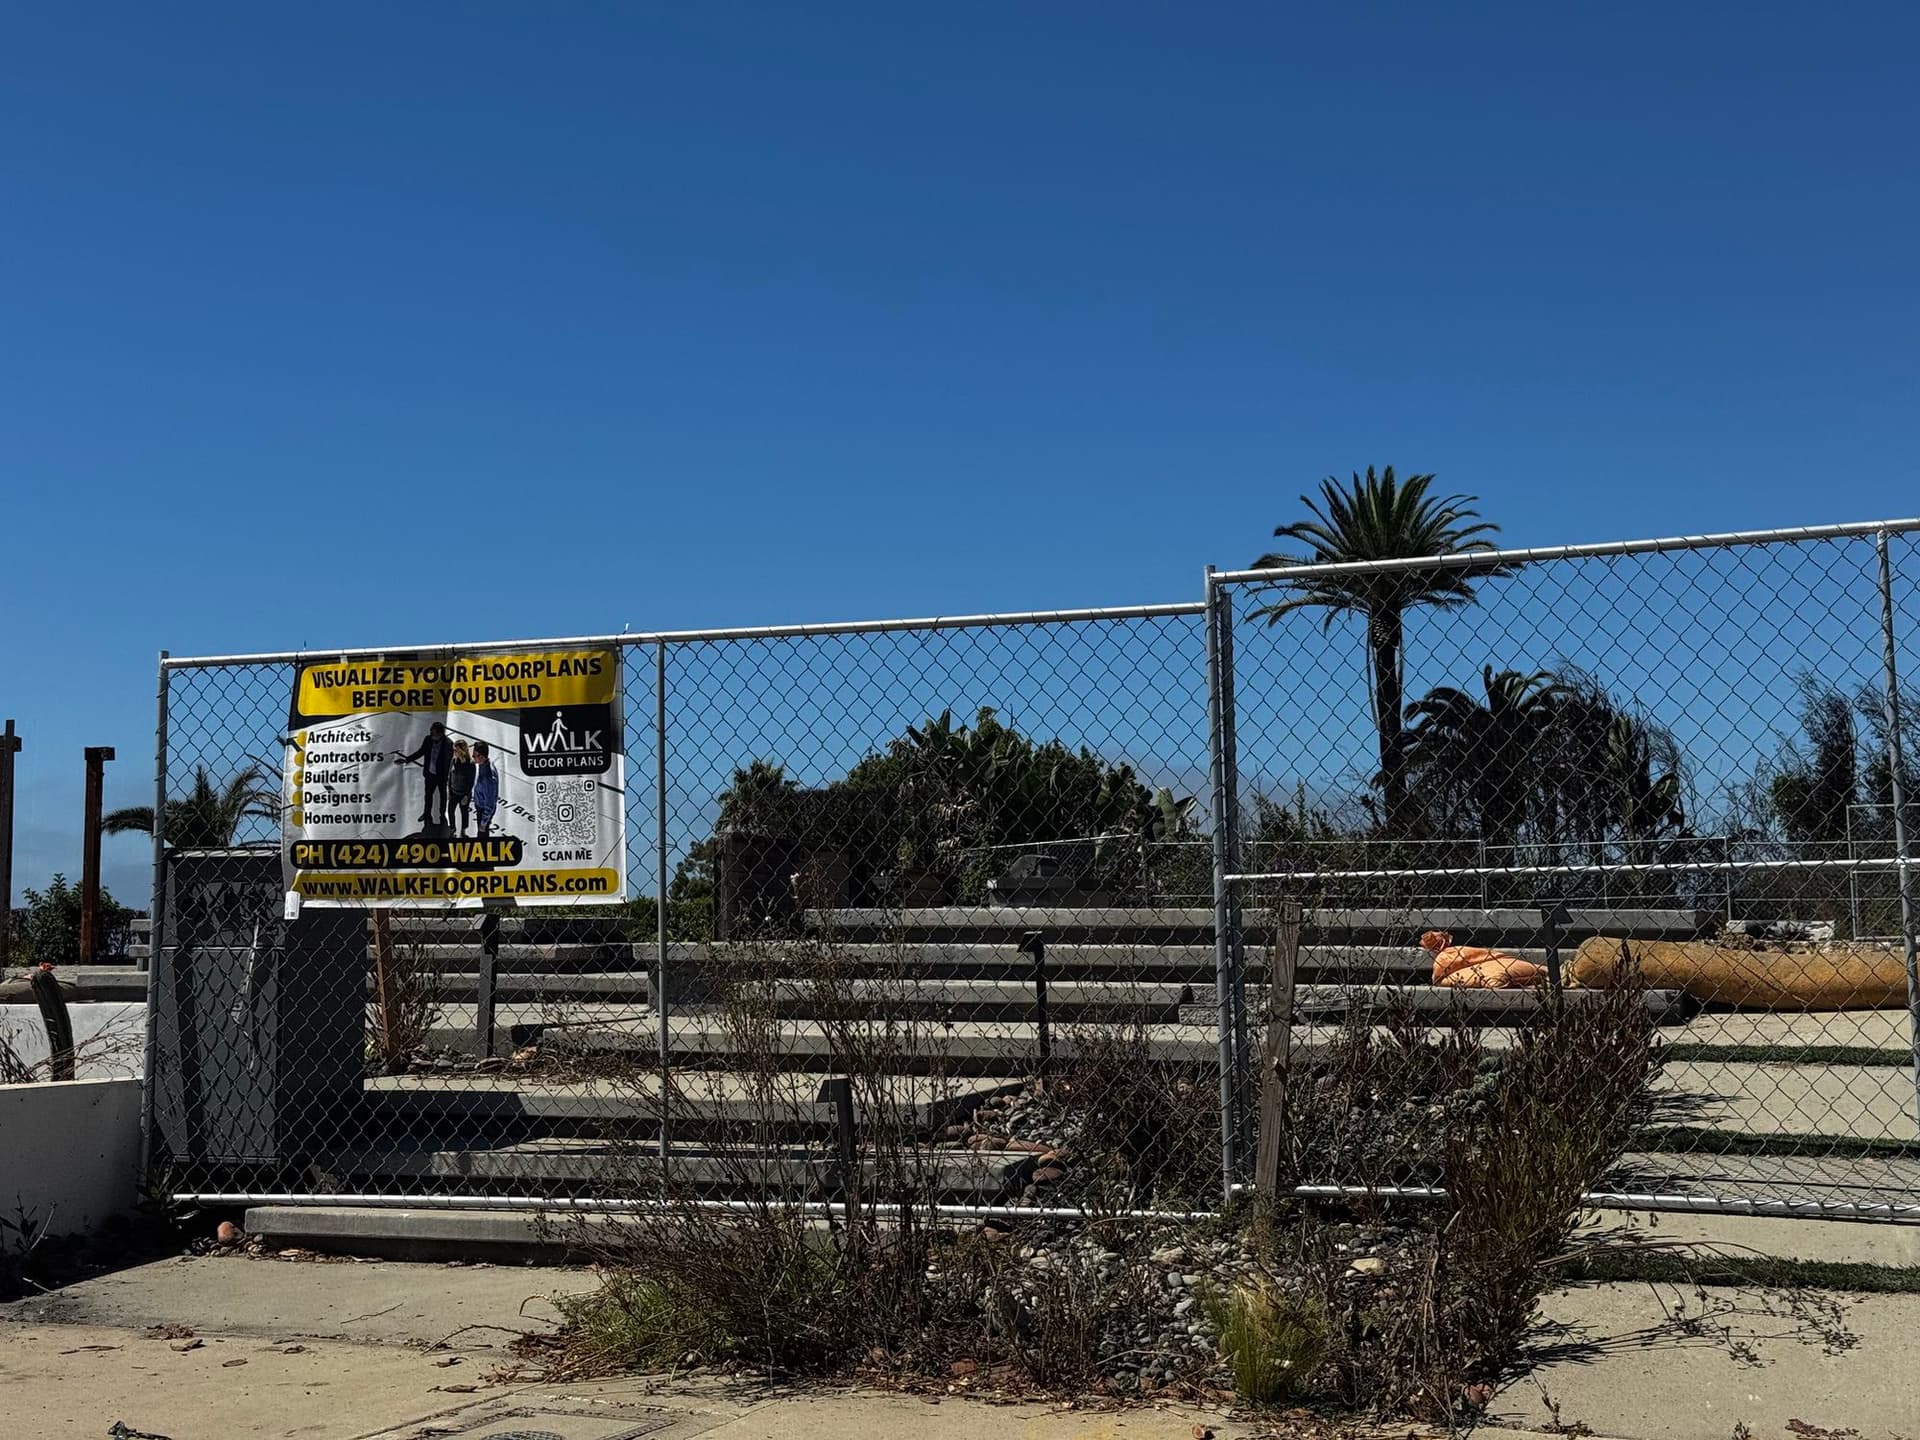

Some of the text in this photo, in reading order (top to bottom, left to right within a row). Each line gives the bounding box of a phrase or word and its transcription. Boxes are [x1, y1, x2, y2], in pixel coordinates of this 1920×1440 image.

[312, 657, 602, 689] VISUALIZE YOUR FLOORPLANS
[352, 684, 541, 708] BEFORE YOU BUILD
[308, 730, 371, 743] Architects
[306, 751, 384, 763] Contractors
[527, 756, 604, 769] FLOOR PLANS
[304, 770, 359, 783] Builders
[304, 791, 371, 807] Designers
[304, 812, 396, 824] Homeowners
[296, 840, 515, 867] PH (424) 490-WALK
[542, 849, 592, 861] SCAN ME
[302, 874, 607, 896] www.WALKFLOORPLANS.com
